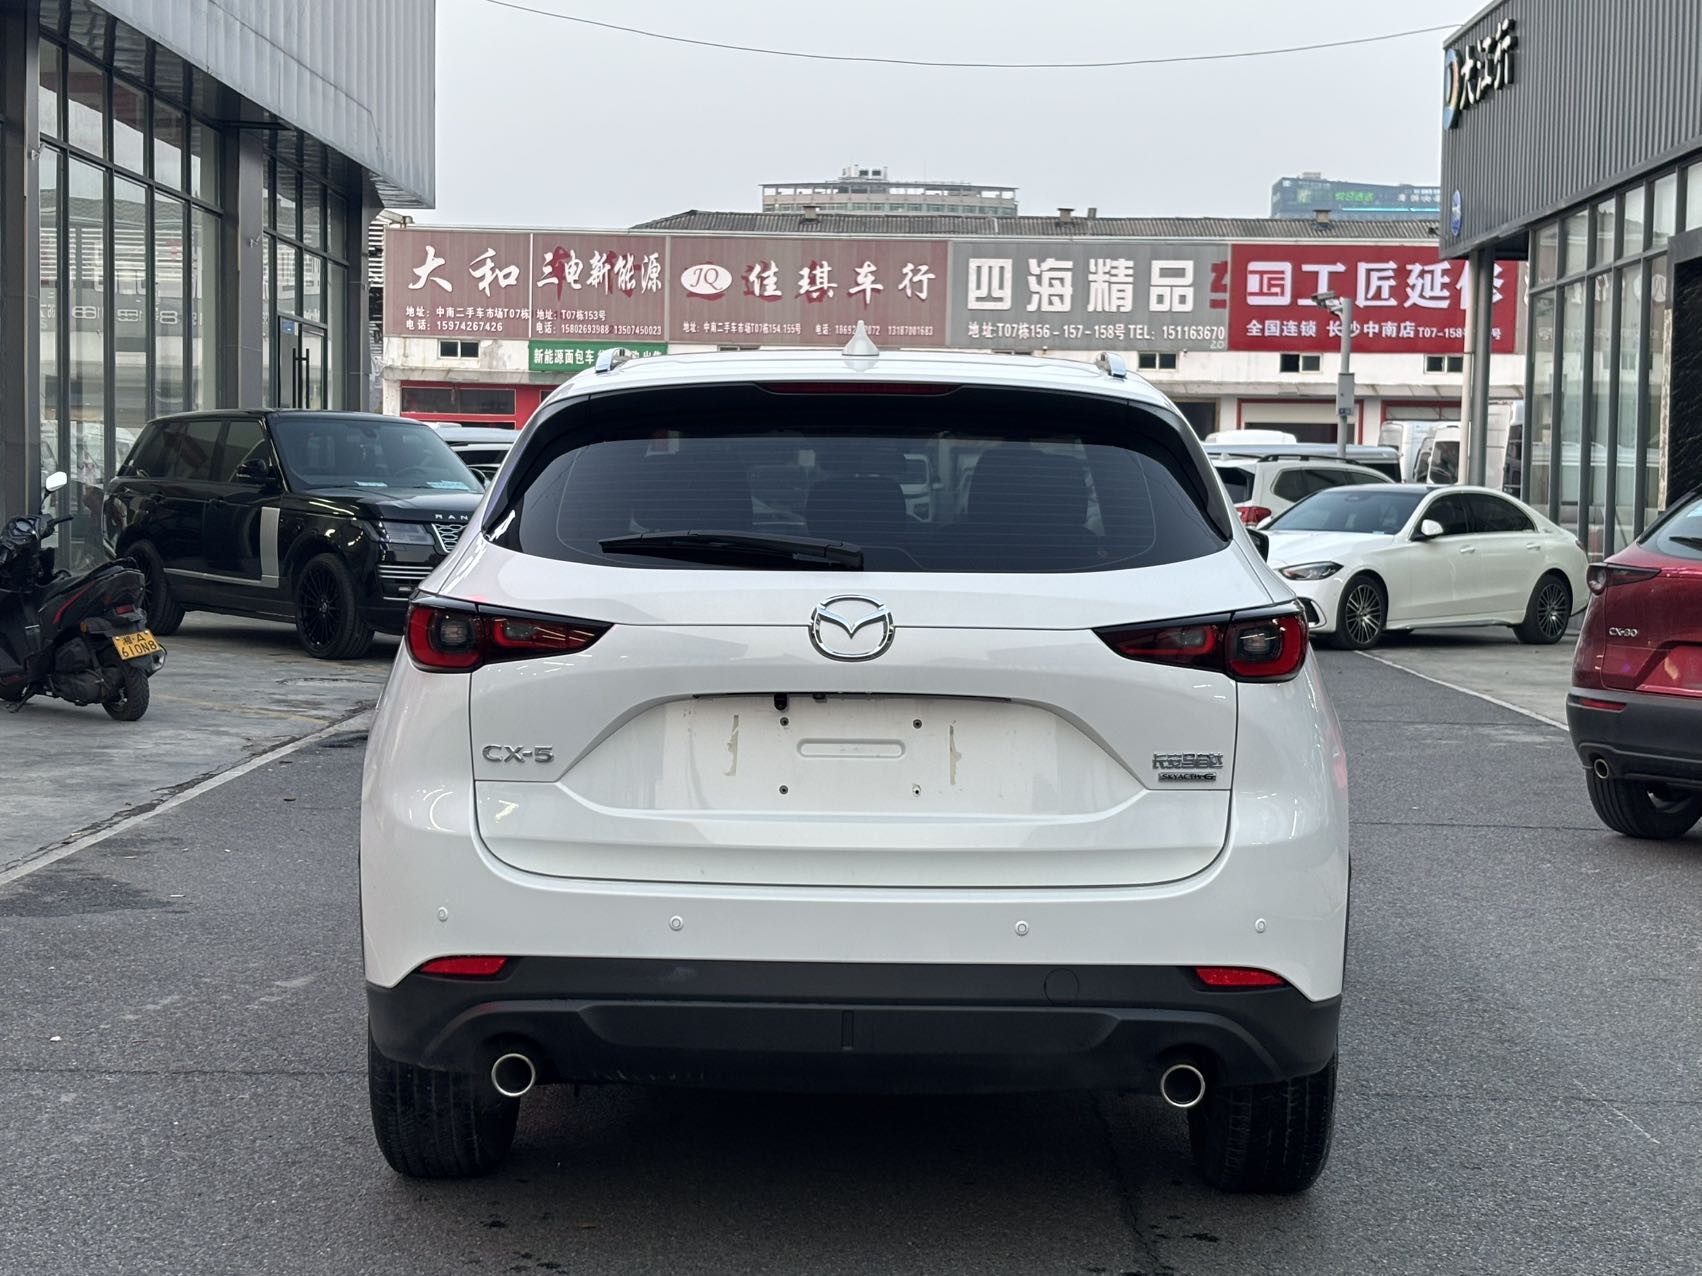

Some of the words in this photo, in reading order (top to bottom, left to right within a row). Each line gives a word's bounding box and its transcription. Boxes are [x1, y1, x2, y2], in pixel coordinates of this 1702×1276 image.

[408, 245, 520, 297] 大和
[536, 249, 663, 296] 三电新能源
[690, 267, 723, 291] JQ
[749, 260, 936, 304] 佳琪车行
[967, 258, 1194, 312] 四海精品
[1246, 319, 1317, 337] 全国连锁
[533, 349, 595, 365] 新能源面包车
[482, 744, 554, 764] CX-5
